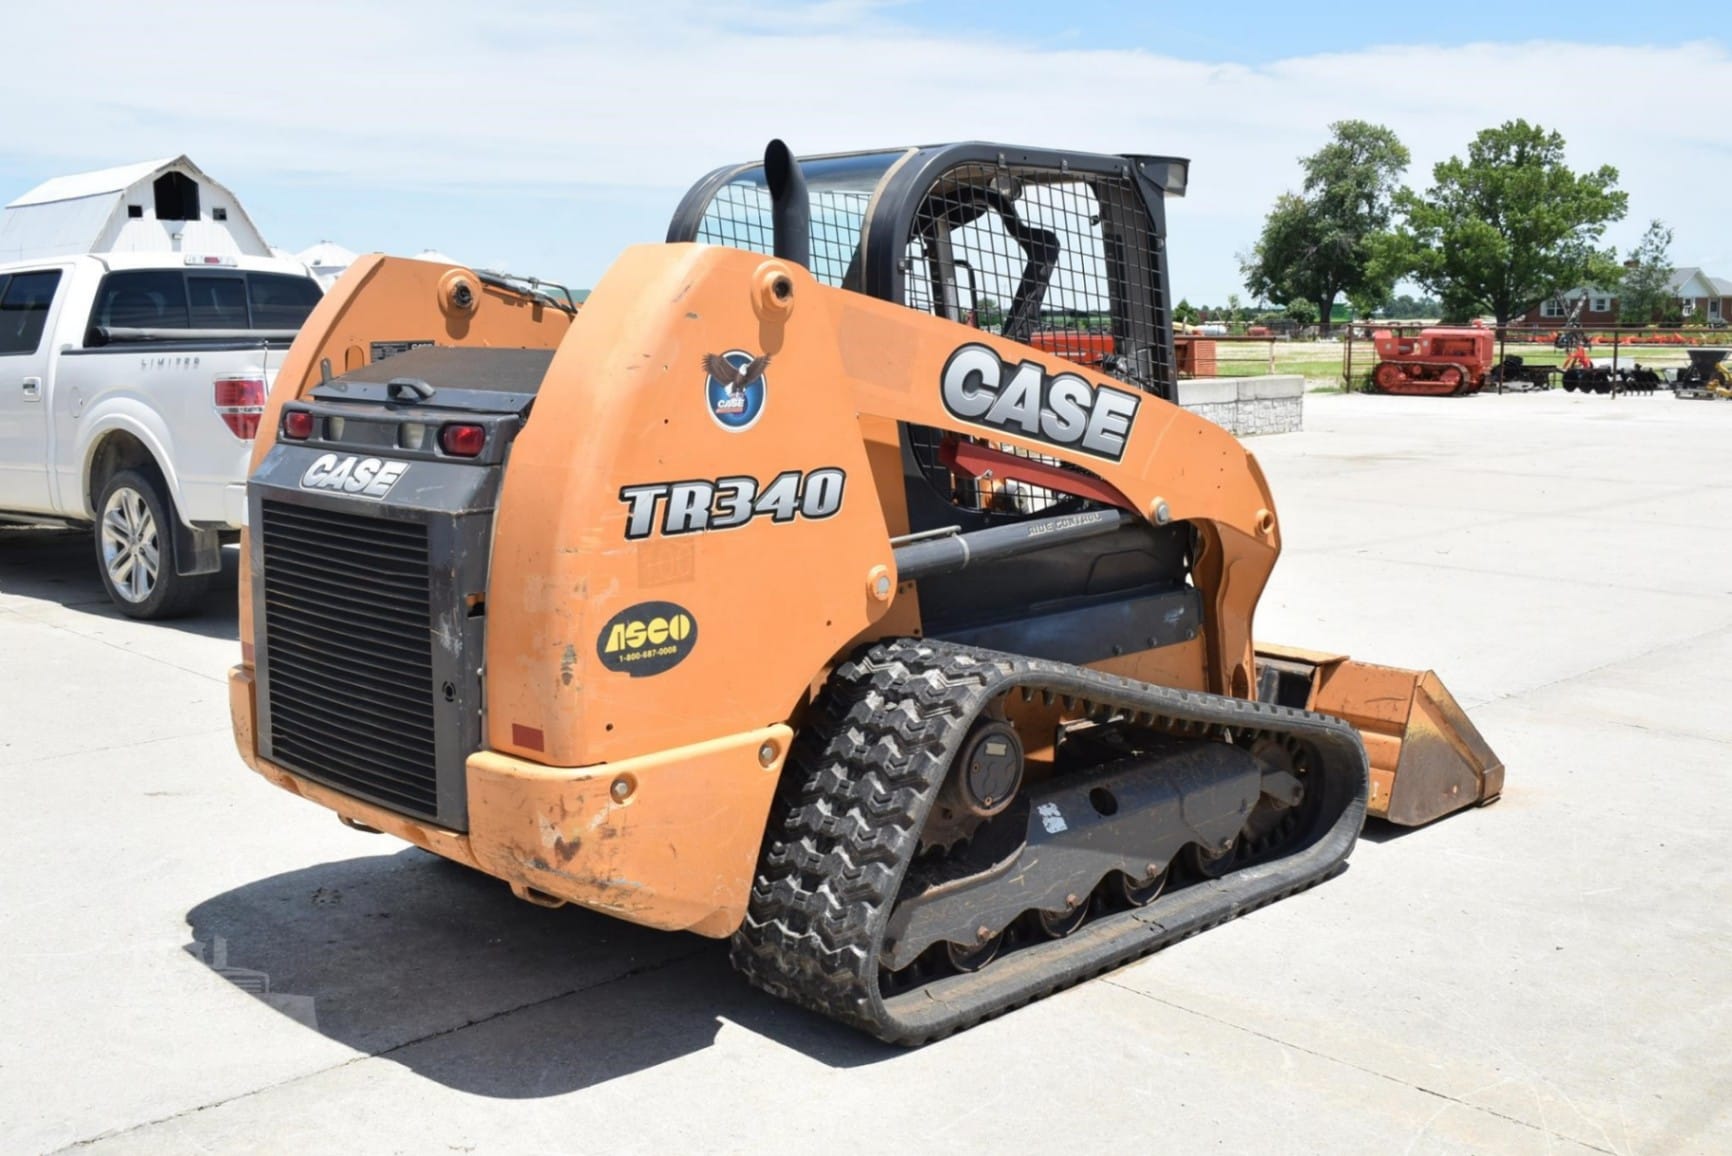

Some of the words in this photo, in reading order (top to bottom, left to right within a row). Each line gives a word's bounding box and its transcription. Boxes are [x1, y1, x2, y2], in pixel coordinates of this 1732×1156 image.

[717, 397, 745, 408] CASE
[941, 343, 1141, 460] CASE
[301, 453, 409, 498] CASE
[619, 467, 846, 540] TR340
[1028, 522, 1054, 536] RIDE
[1056, 511, 1102, 531] CONTROL
[604, 614, 690, 653] ASCO
